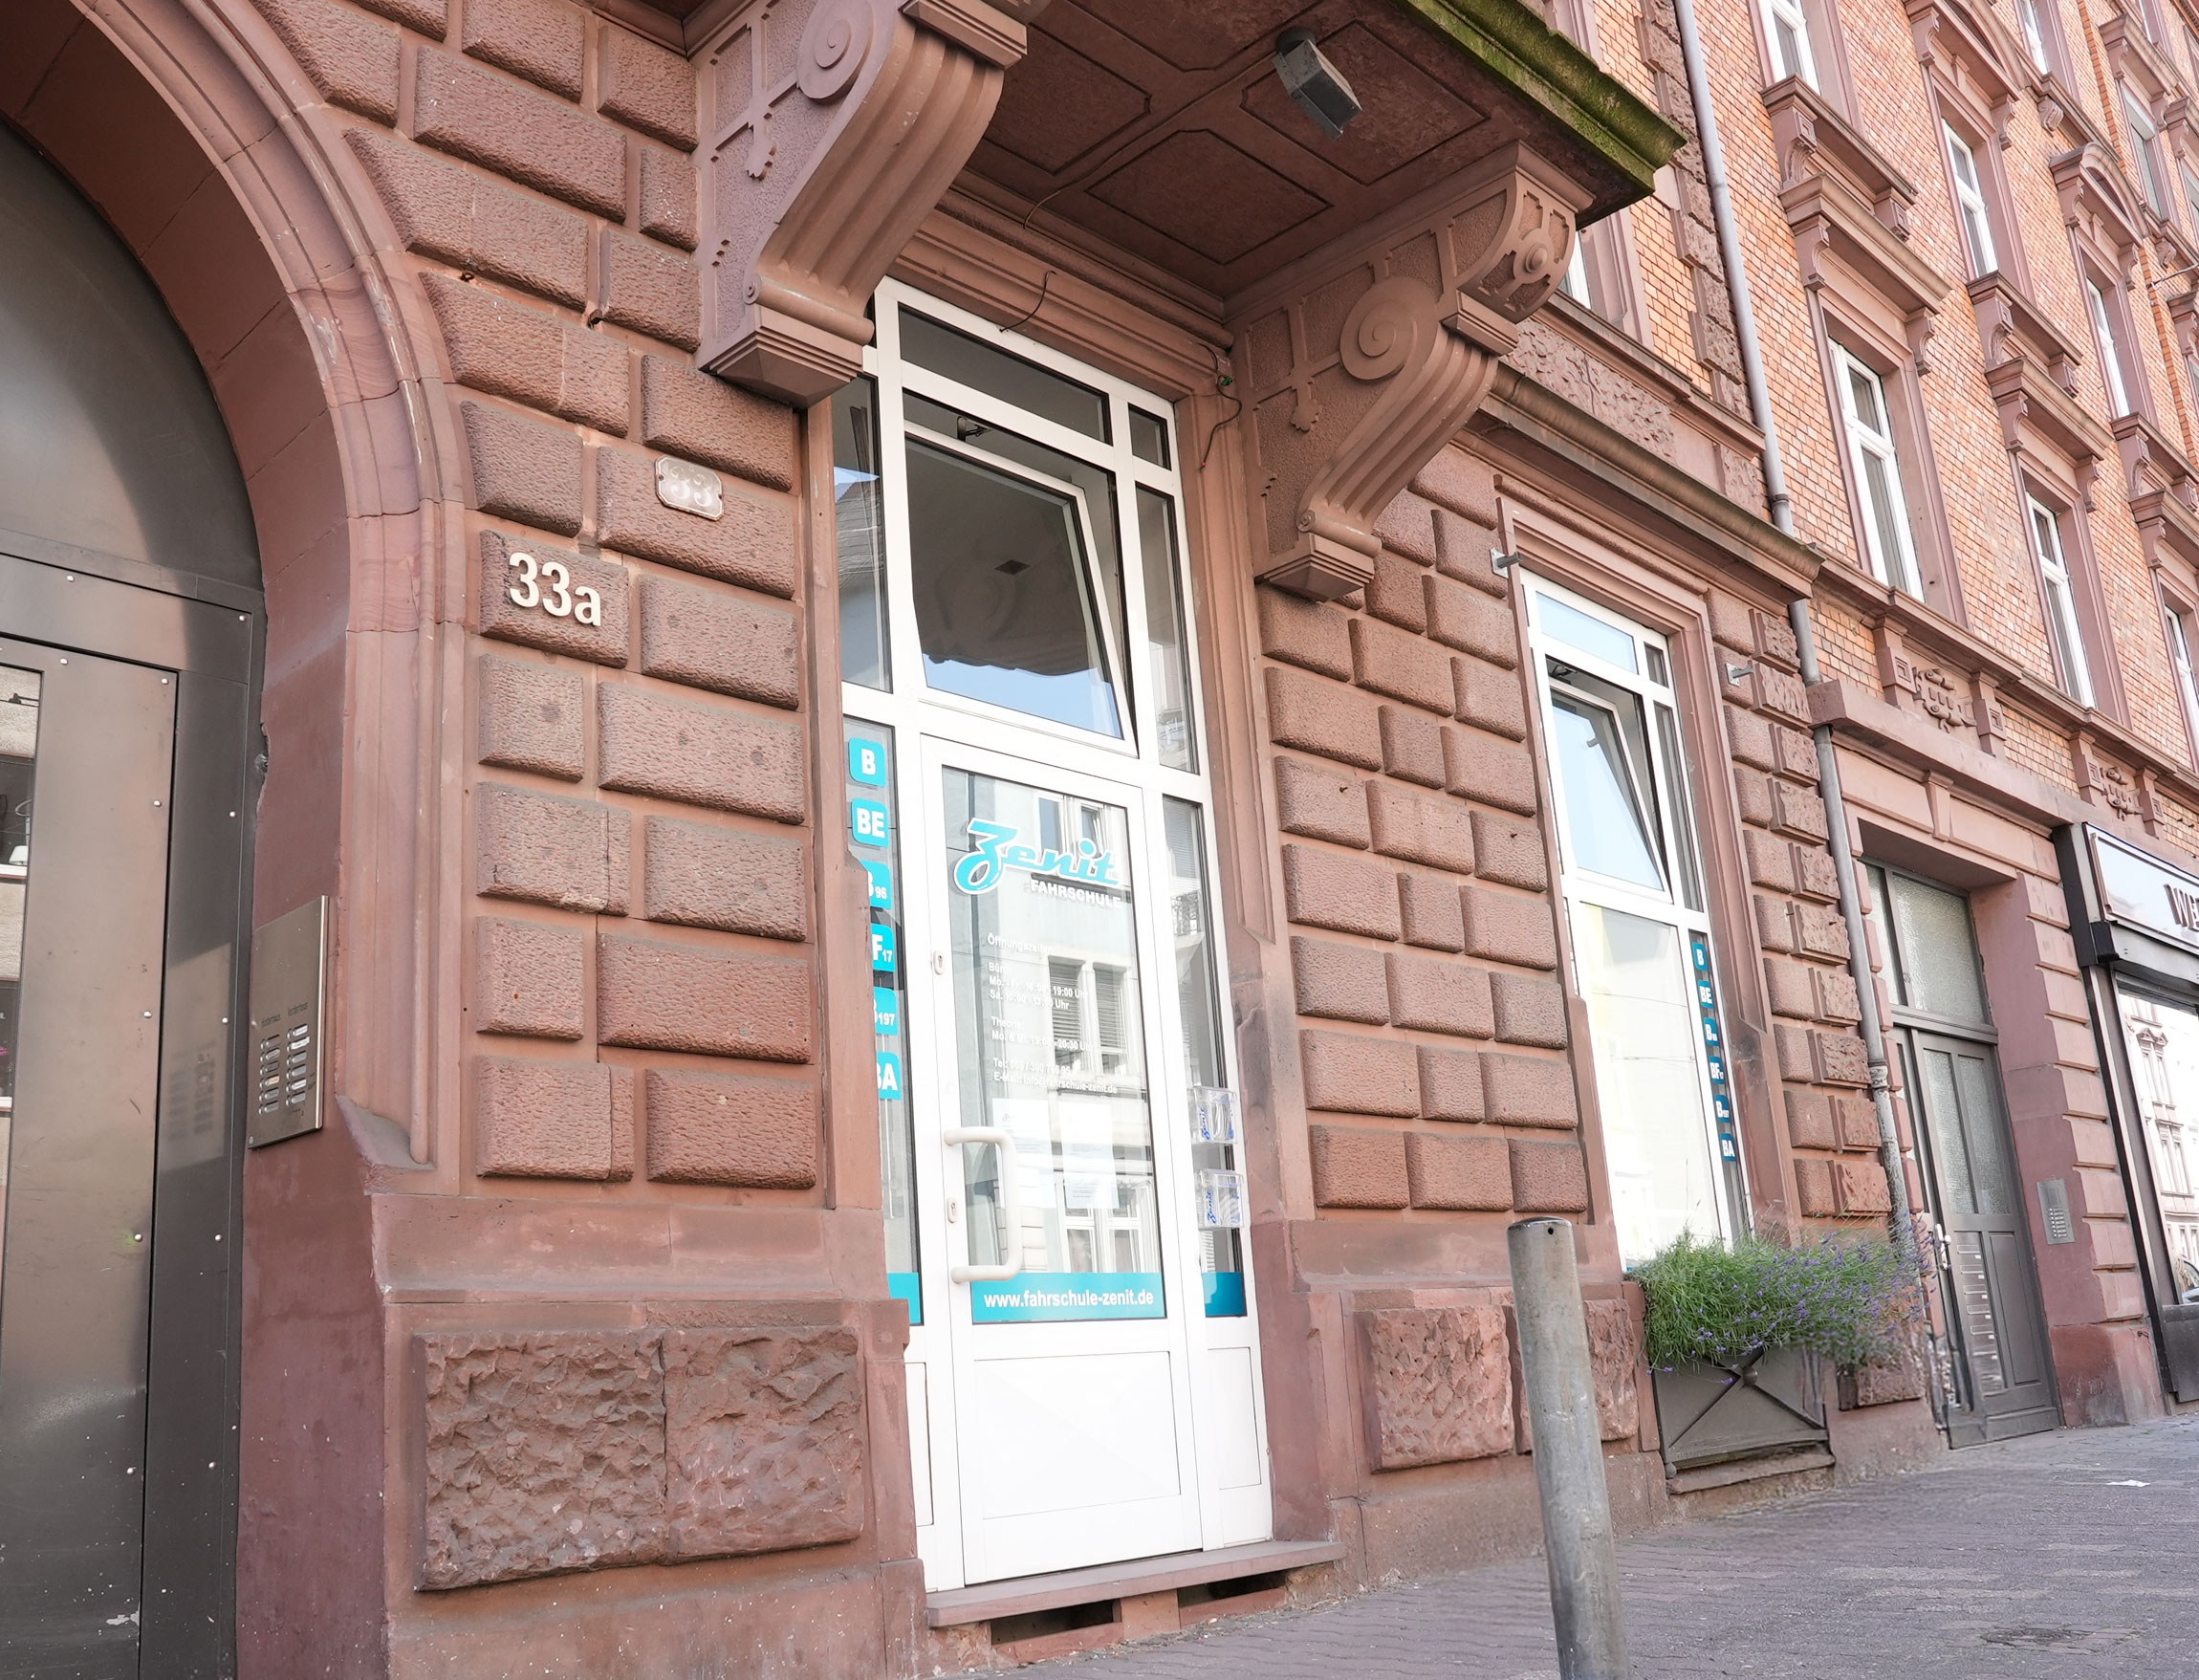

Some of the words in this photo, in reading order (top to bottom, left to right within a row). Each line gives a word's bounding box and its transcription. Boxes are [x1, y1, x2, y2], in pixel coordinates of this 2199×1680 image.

[509, 552, 601, 626] 33a
[861, 749, 876, 775] B
[857, 808, 885, 839] BE
[953, 818, 1122, 895] Zenit
[1031, 879, 1121, 909] FAHRSCHULE
[872, 933, 892, 962] F17
[1696, 949, 1705, 966] B
[1053, 986, 1073, 997] 19:00
[1699, 986, 1712, 1004] BE
[874, 998, 896, 1026] 197
[1055, 999, 1070, 1011] Uhr
[1057, 1038, 1078, 1050] 20:30
[1722, 1139, 1735, 1157] BA
[984, 1288, 1154, 1308] www.fahrschule-zenit.de
